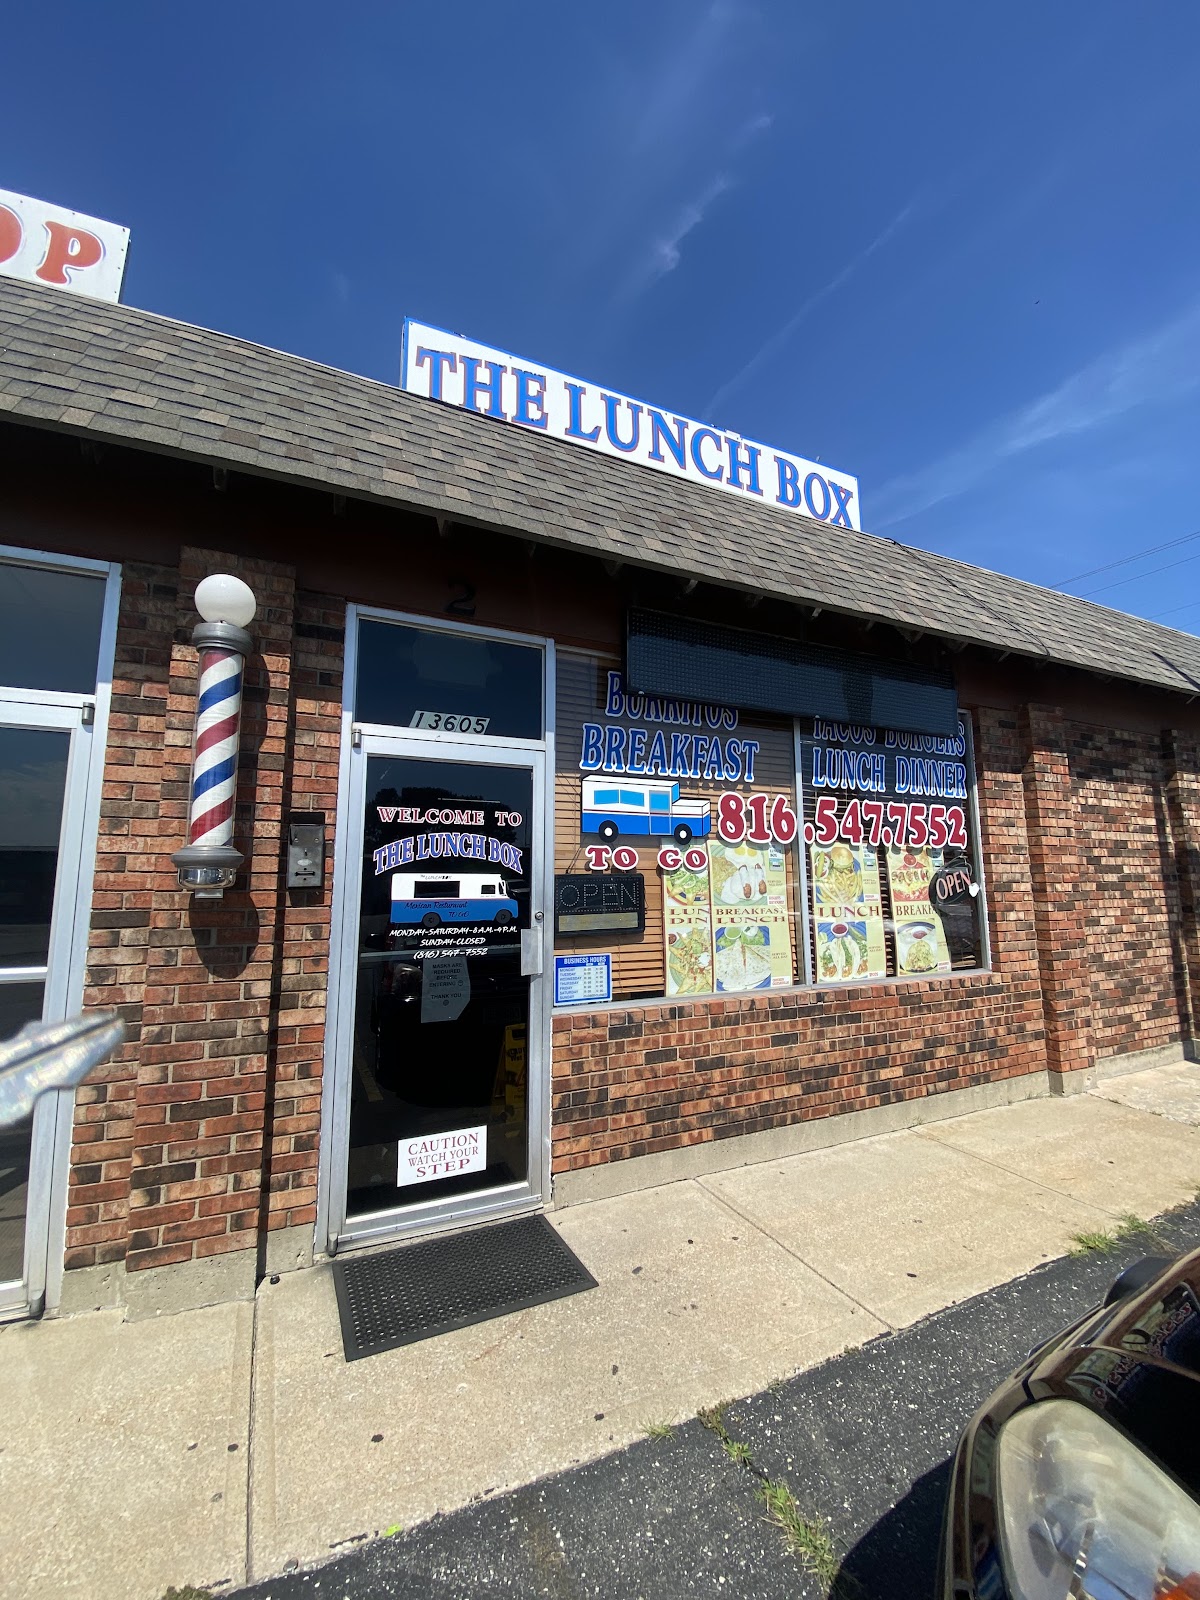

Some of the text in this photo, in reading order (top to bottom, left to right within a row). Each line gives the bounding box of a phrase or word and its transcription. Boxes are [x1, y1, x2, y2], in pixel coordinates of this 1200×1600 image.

[416, 346, 854, 528] THE LUNCH BOX
[415, 712, 486, 734] 13605
[579, 722, 760, 783] BREAKFAST
[812, 747, 967, 799] LUNCH DINNER
[376, 806, 523, 827] WELCOME TO
[373, 832, 524, 876] THE LUNCH BOX
[585, 845, 709, 871] TO GO
[559, 882, 637, 907] OPEN
[936, 869, 971, 900] OPEN
[717, 916, 785, 924] LUNCH
[818, 905, 880, 918] LUNCH
[420, 937, 486, 947] SUNDAY-CLOSED
[413, 948, 489, 960] (816) 547-7552
[564, 957, 589, 965] BUSINESS
[408, 1132, 479, 1156] CAUTION
[408, 1146, 479, 1167] WATCH YOUR
[416, 1158, 471, 1178] STEP
